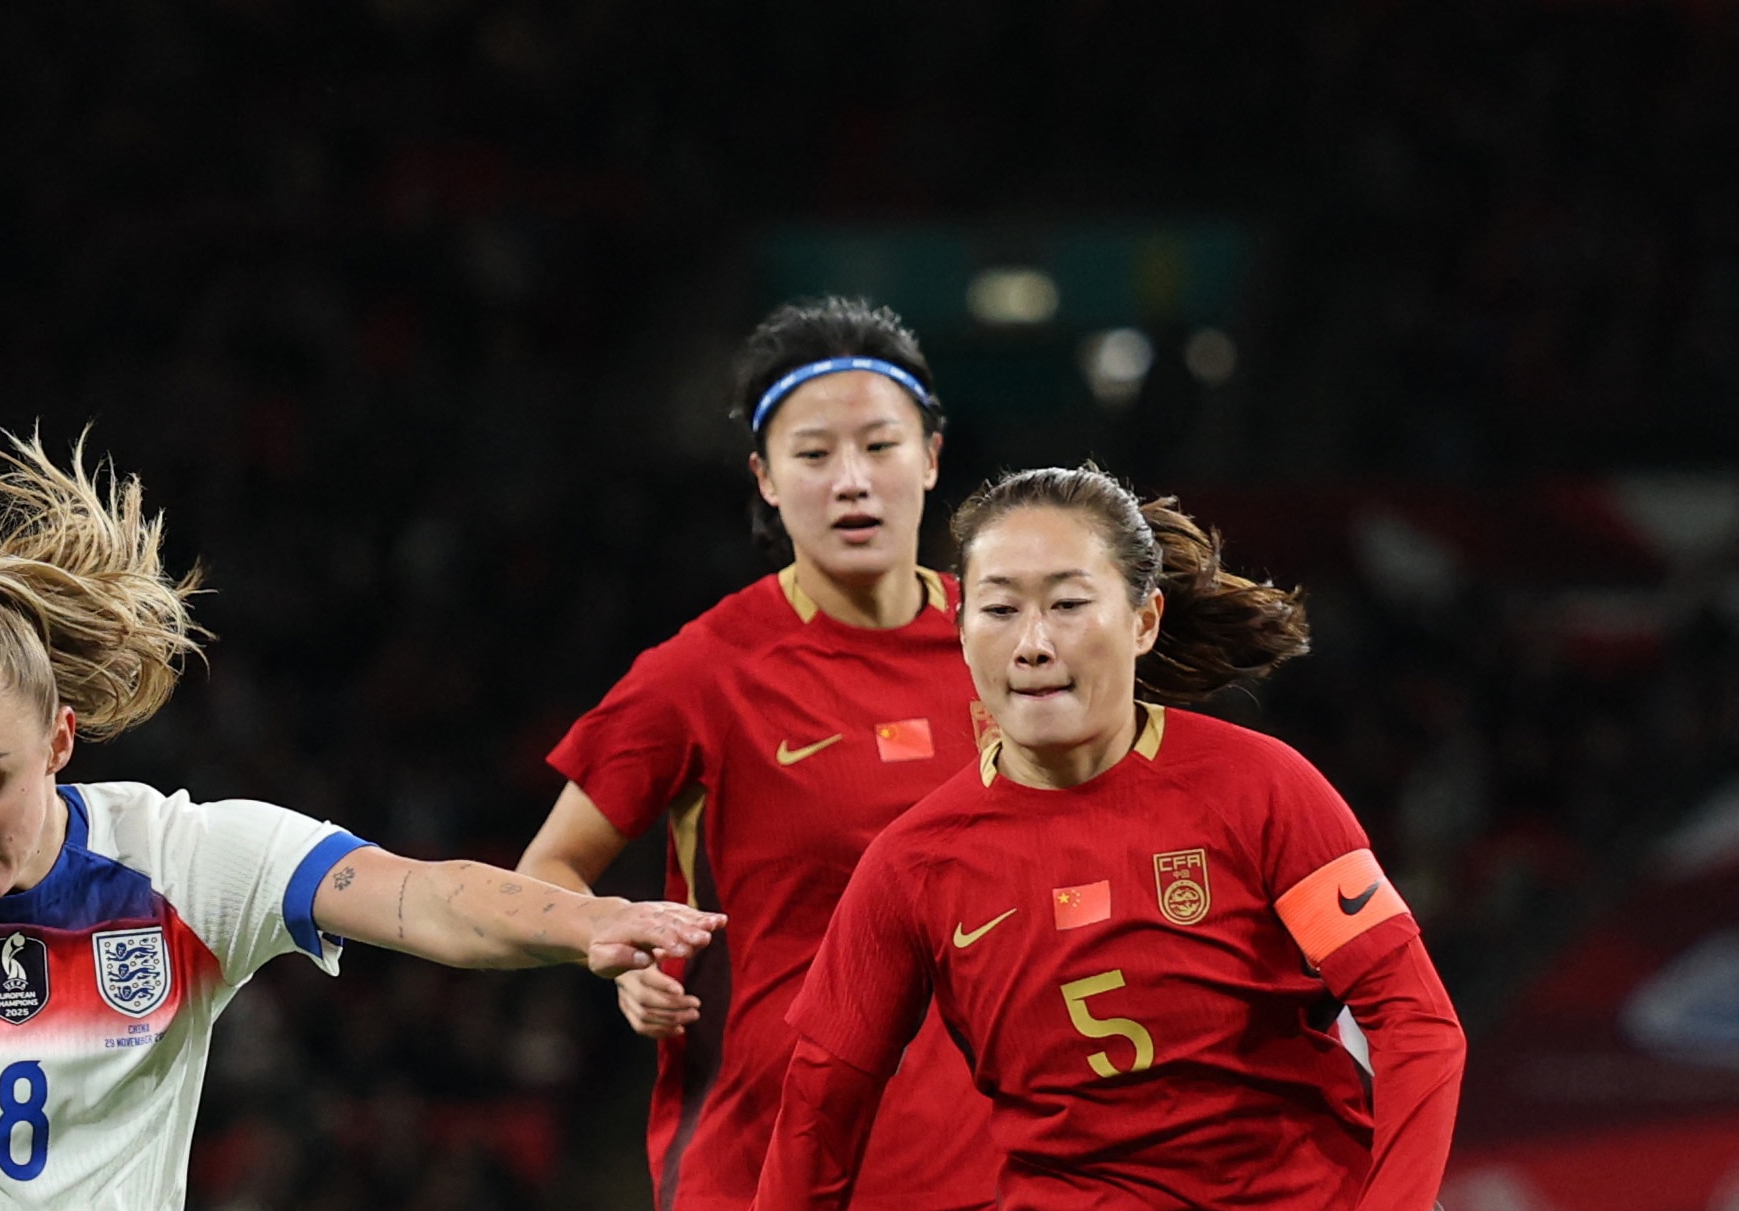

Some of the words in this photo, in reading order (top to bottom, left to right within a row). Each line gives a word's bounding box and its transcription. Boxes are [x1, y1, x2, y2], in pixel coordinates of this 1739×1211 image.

[1158, 854, 1201, 872] CFA
[5, 1008, 30, 1017] 2025
[1060, 968, 1154, 1079] 5
[117, 1035, 153, 1047] NOVEMBER
